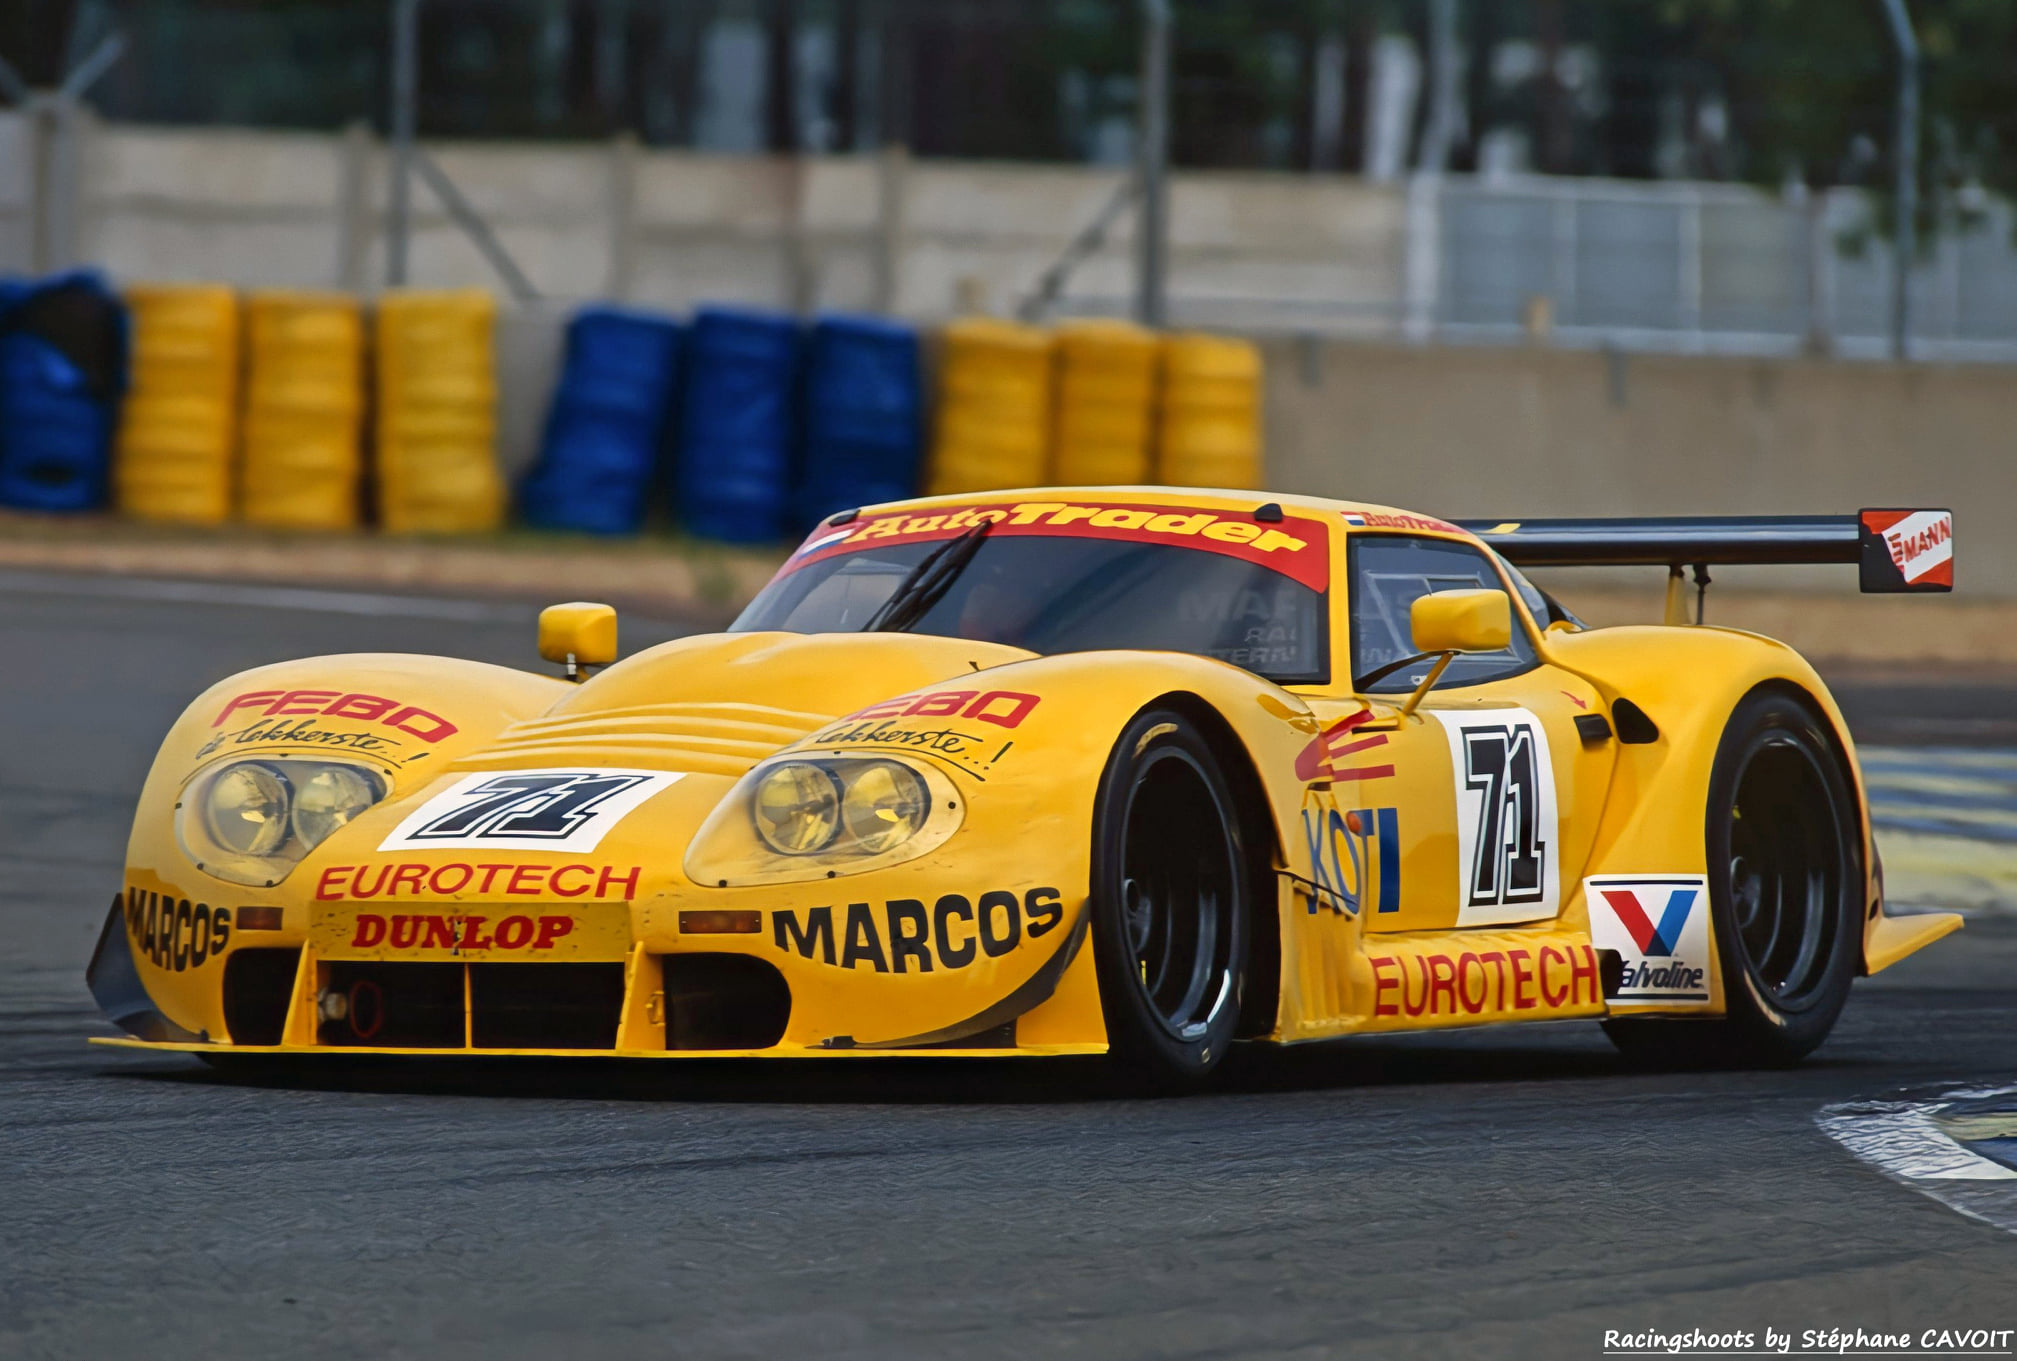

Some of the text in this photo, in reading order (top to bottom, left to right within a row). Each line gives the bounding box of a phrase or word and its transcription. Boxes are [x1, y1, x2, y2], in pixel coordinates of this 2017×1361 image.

[843, 503, 1308, 553] AutoTrader
[1903, 516, 1952, 563] MANN
[211, 690, 459, 744] FEBO
[404, 773, 656, 841] 71
[1459, 723, 1546, 908] 71
[315, 863, 642, 901] EUROTECH
[126, 886, 232, 973] MARCOS
[351, 914, 575, 950] DUNLOP
[771, 886, 1064, 974] MARCOS
[1368, 944, 1600, 1018] EUROTECH
[1617, 960, 1705, 990] alvoline
